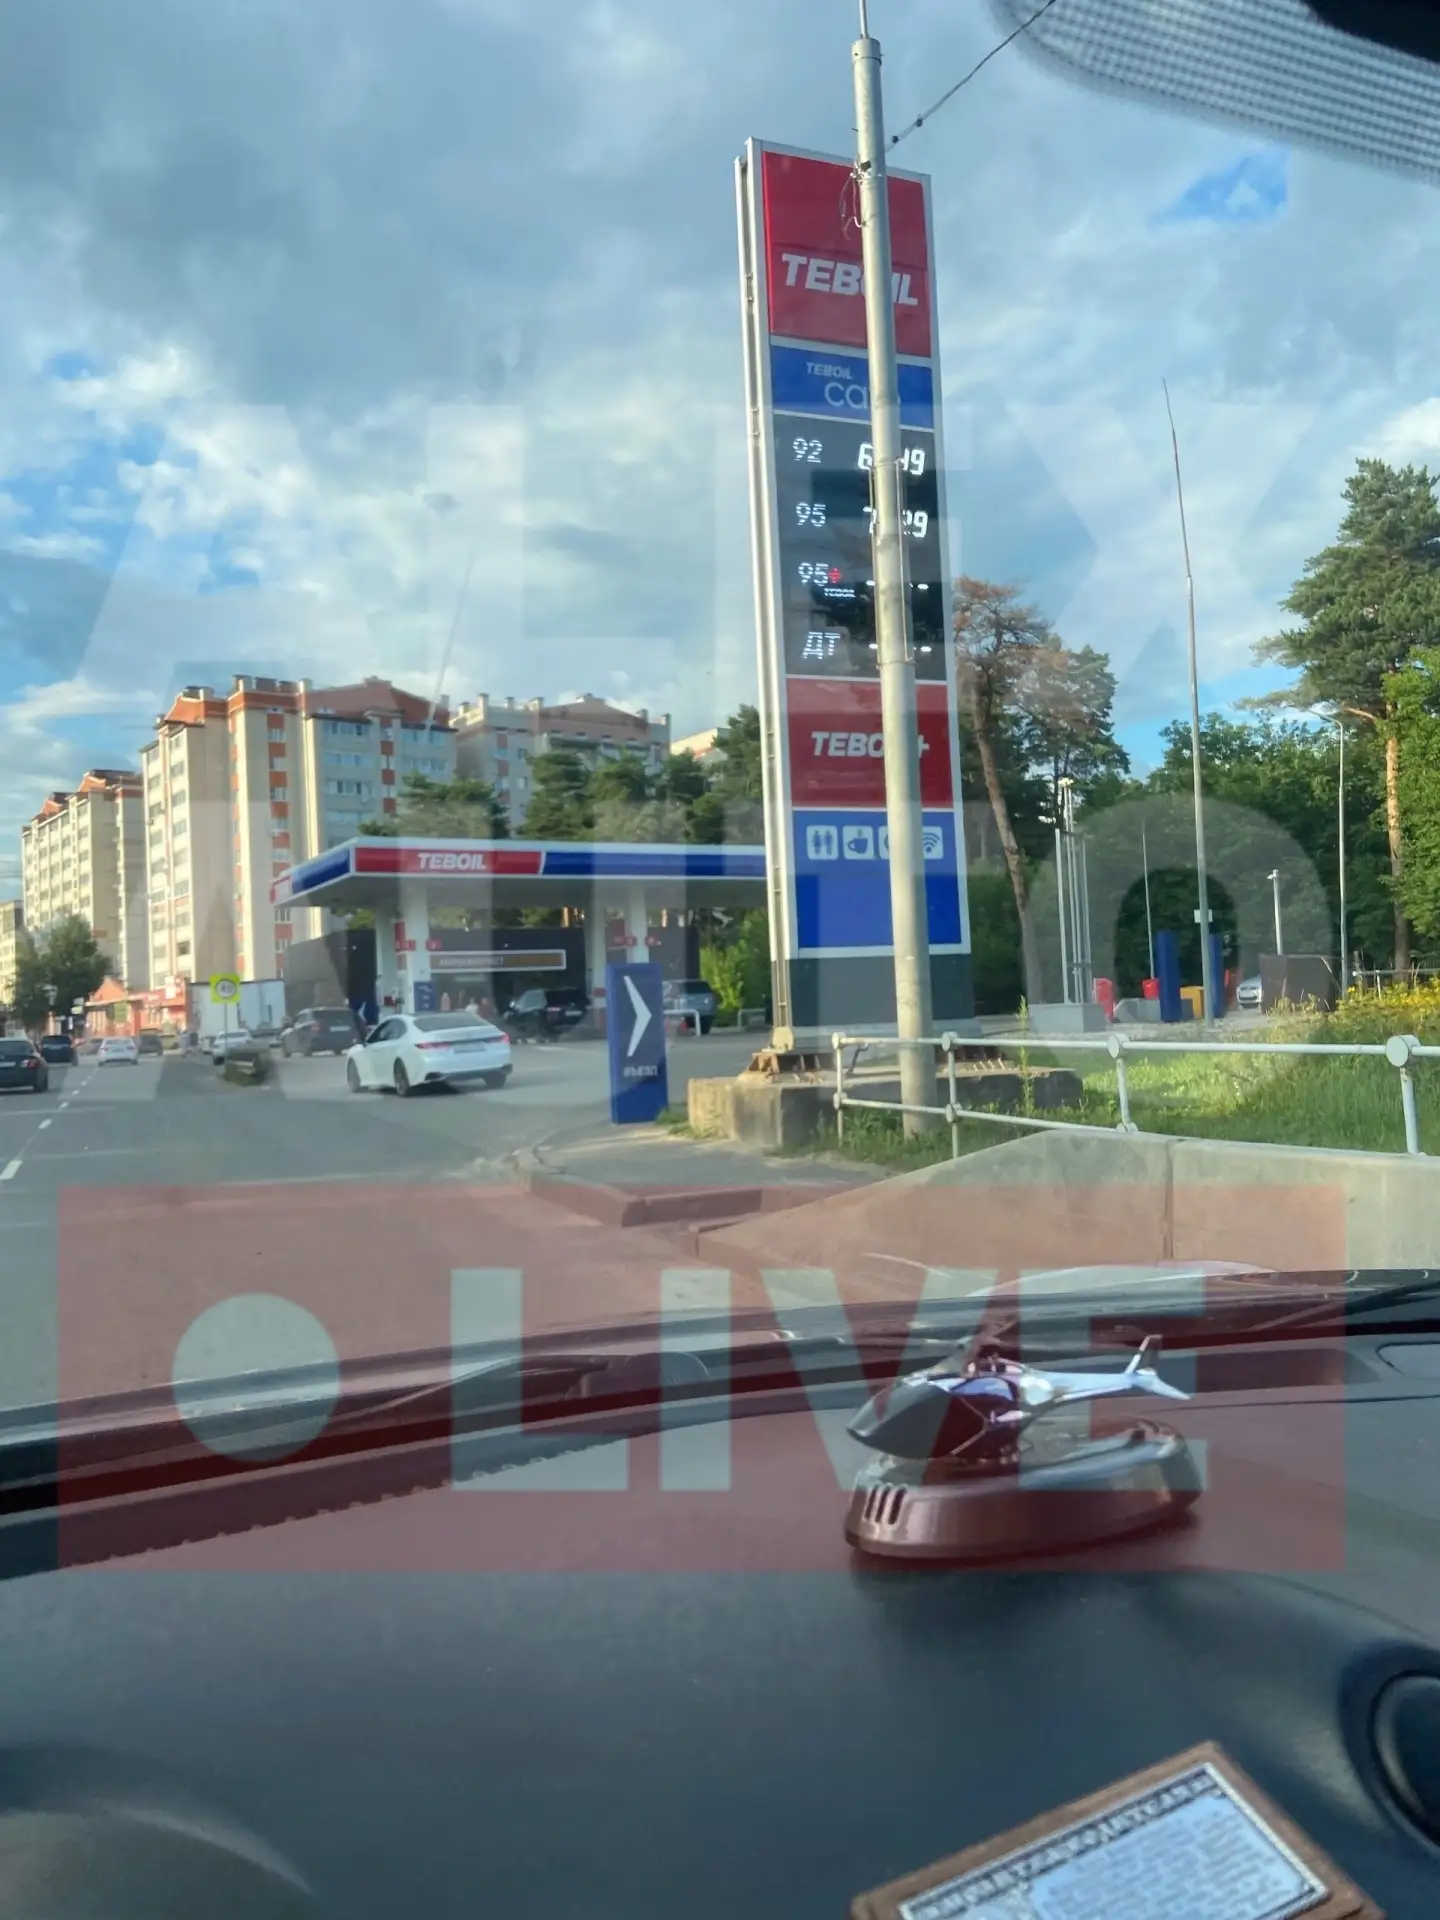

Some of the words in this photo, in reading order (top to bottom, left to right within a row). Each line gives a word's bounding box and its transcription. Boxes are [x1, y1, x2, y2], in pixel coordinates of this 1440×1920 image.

[782, 253, 918, 306] TEBIL
[806, 362, 853, 380] TEBOIL
[792, 437, 823, 464] 92
[795, 502, 827, 527] 95
[802, 631, 840, 660] ДТ
[417, 851, 487, 871] TEBOIL
